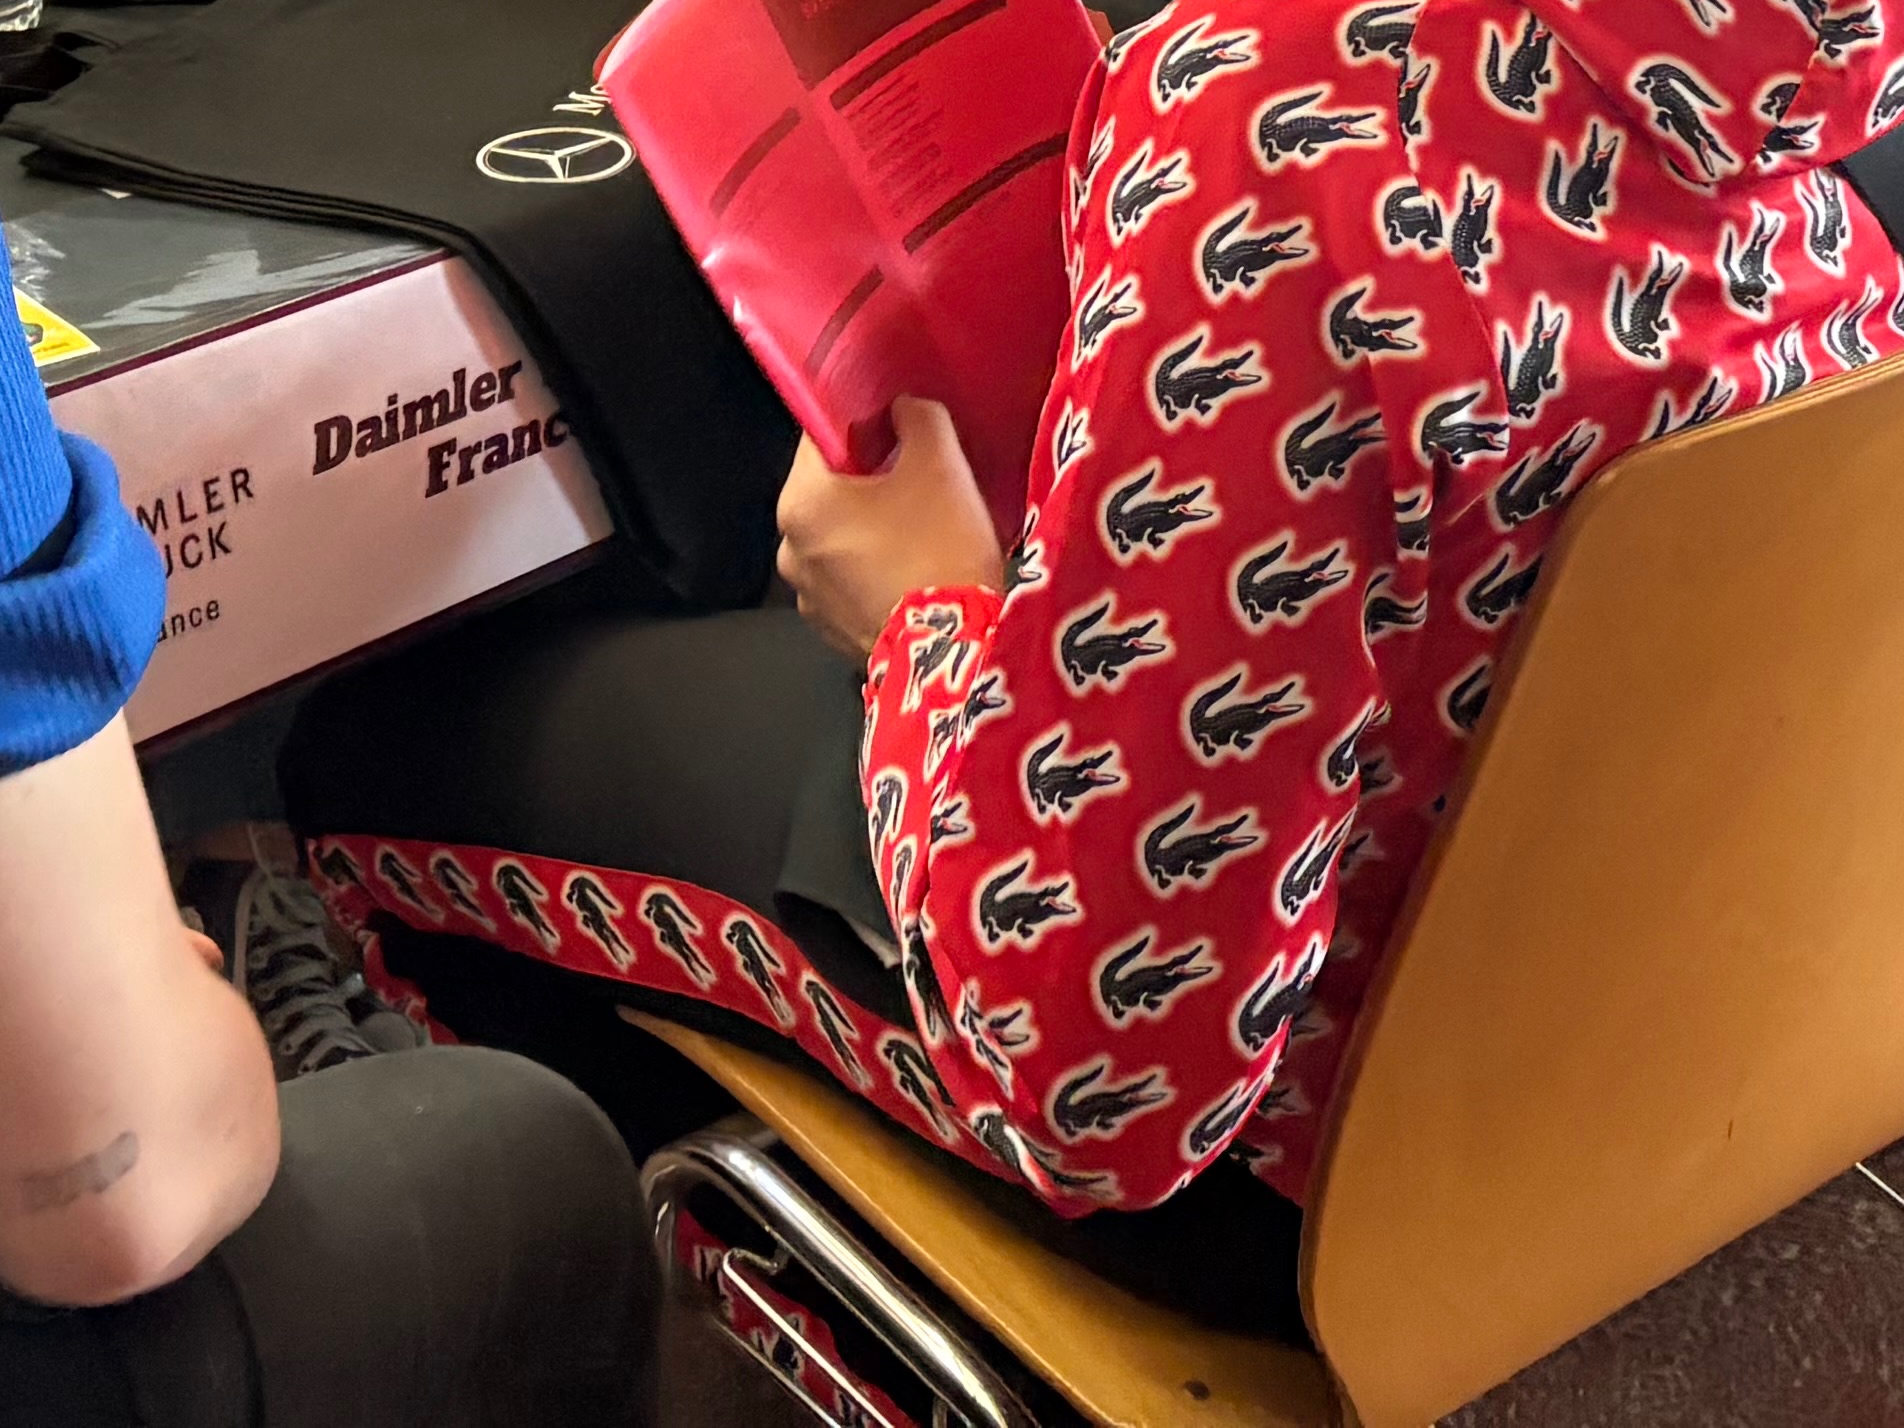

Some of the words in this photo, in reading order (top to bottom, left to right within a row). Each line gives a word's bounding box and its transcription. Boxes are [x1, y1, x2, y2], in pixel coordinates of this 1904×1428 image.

[312, 360, 523, 476] Daimler
[424, 412, 570, 499] Franc
[136, 468, 254, 536] MLER
